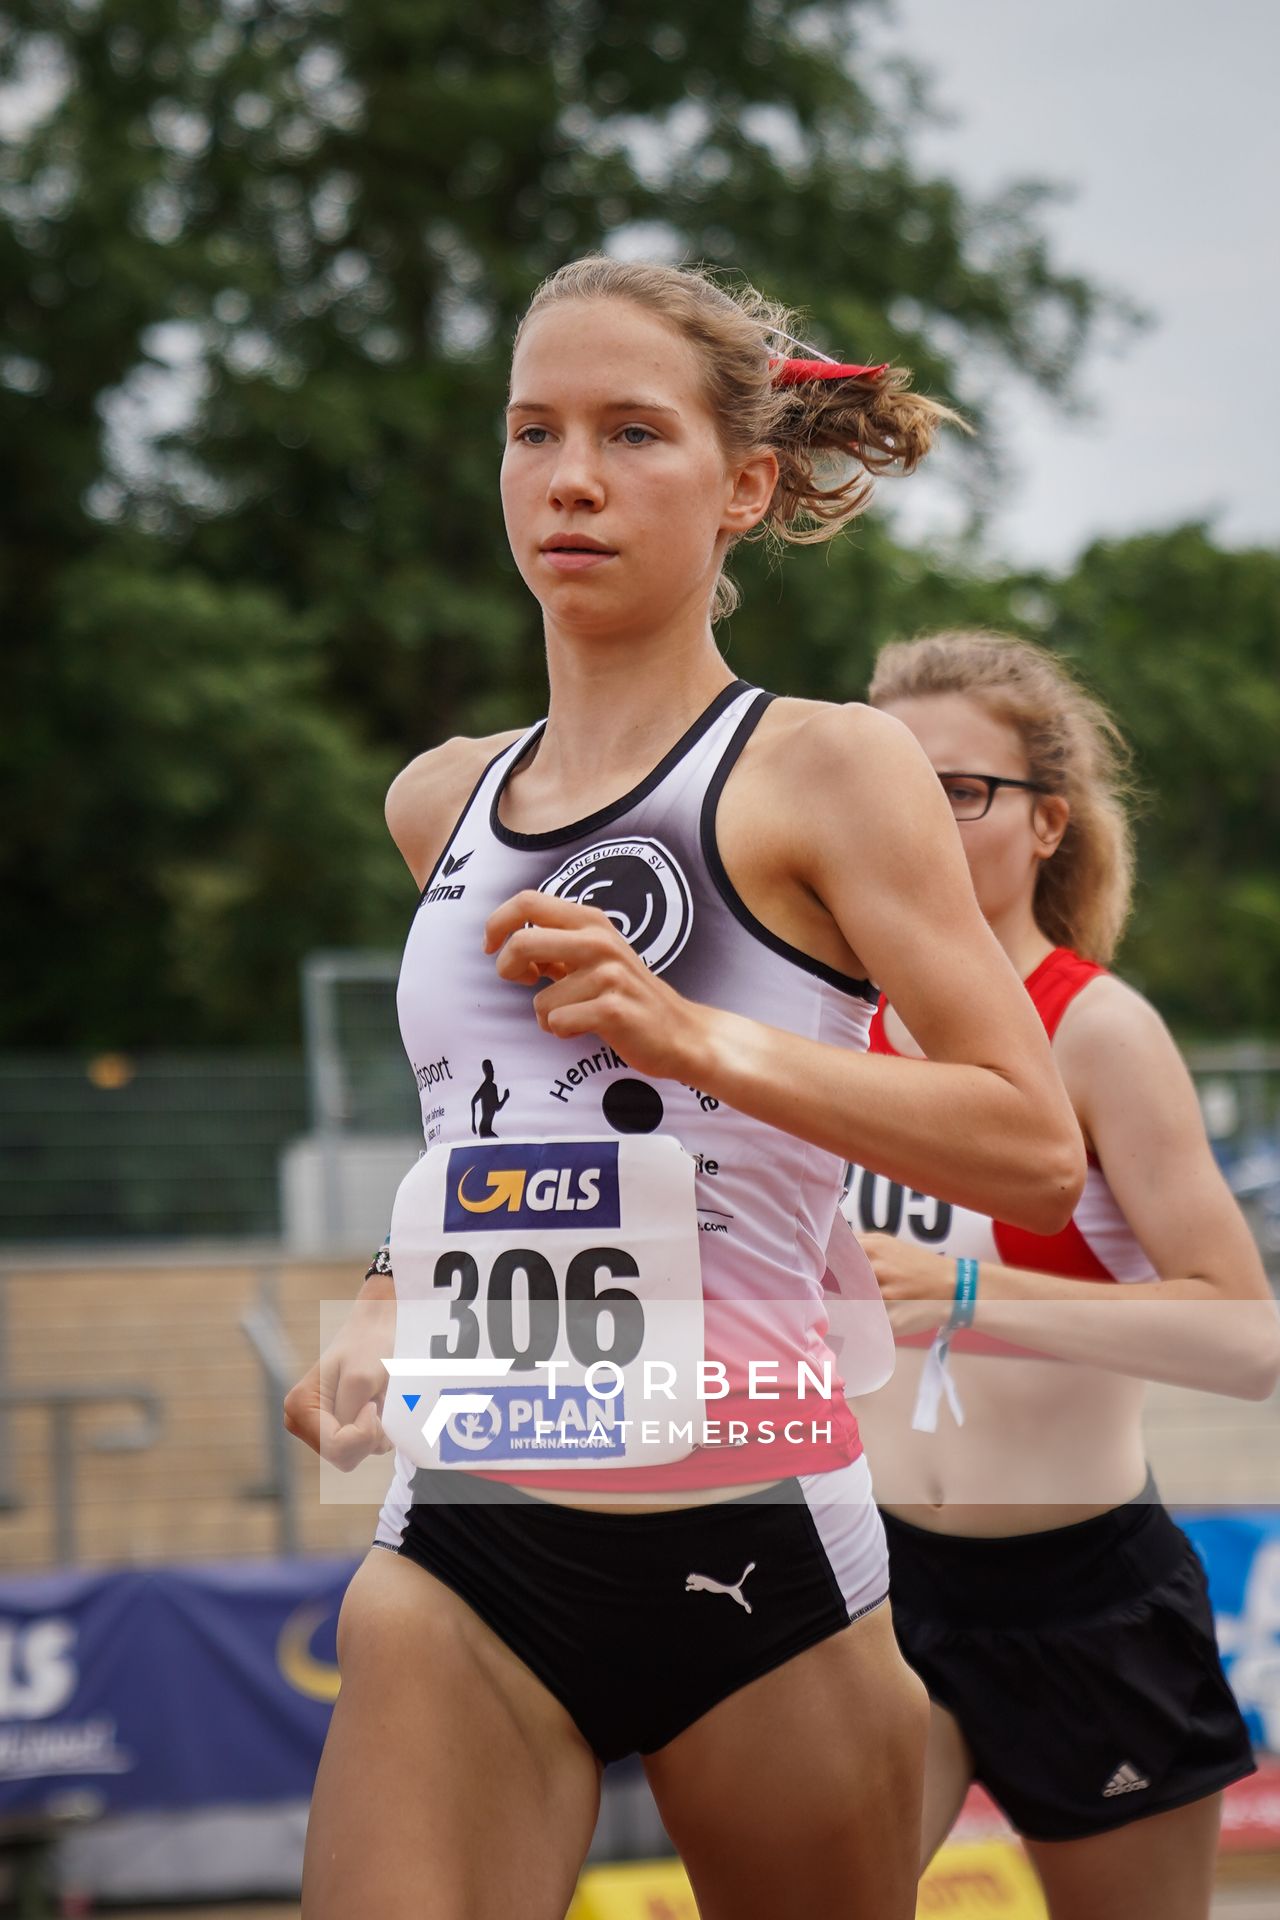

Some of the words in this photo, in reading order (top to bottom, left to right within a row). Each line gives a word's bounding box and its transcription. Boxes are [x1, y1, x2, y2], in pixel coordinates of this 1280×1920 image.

[649, 856, 665, 871] SV
[525, 1168, 601, 1212] GLS
[843, 1162, 953, 1244] 05
[430, 1248, 645, 1372] 306
[509, 1400, 615, 1432] PLAN
[510, 1437, 616, 1449] INTERNATIONAL
[1103, 1780, 1149, 1798] adidas
